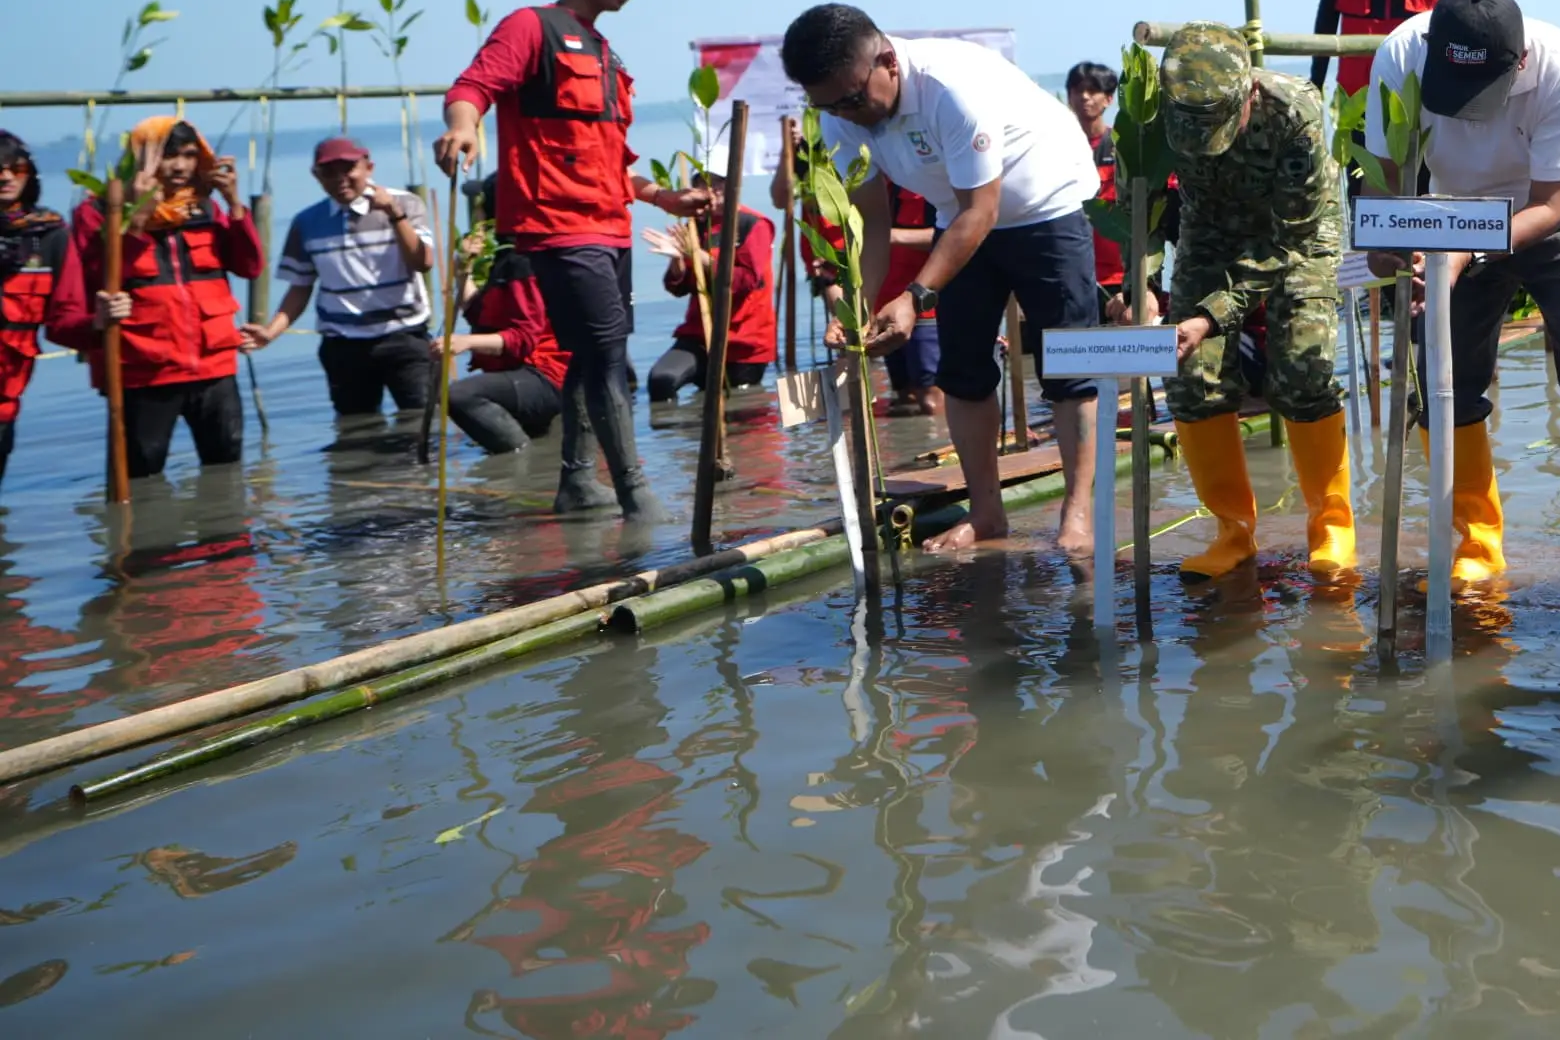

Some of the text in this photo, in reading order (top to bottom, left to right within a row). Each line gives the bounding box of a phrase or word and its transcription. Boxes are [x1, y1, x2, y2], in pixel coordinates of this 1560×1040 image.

[1360, 214, 1504, 230] PT. Semen Tonasa
[1046, 343, 1174, 355] Komandan KODIM 1421/Pangkep
